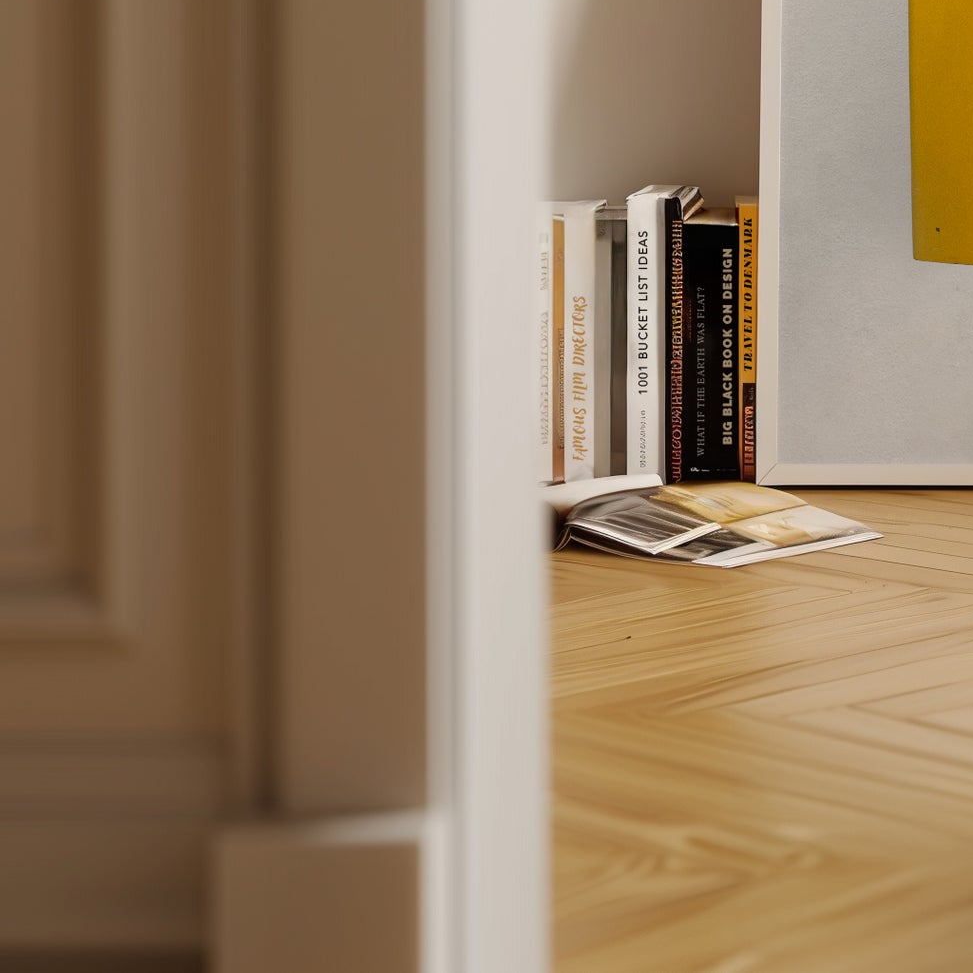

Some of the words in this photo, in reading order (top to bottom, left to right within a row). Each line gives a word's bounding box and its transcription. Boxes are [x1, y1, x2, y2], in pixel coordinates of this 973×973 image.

[638, 230, 648, 270] IDEAS
[743, 217, 753, 289] DENMARK
[638, 275, 648, 301] LIST
[722, 248, 733, 299] DESIGN
[697, 287, 705, 319] FLAT?
[722, 304, 733, 325] ON
[743, 293, 753, 311] TO
[572, 296, 587, 366] DIRECTORS
[638, 306, 648, 359] BUCKET
[697, 322, 705, 343] WAS
[743, 316, 753, 371] TRAVEL
[722, 329, 733, 368] BOOK
[638, 365, 648, 395] 1001
[697, 348, 705, 384] EARTH
[697, 387, 705, 408] THE
[722, 372, 733, 416] BLACK
[697, 411, 705, 422] IF
[722, 421, 733, 445] BIG
[572, 407, 587, 461] FAMOUS
[697, 426, 705, 456] WHAT
